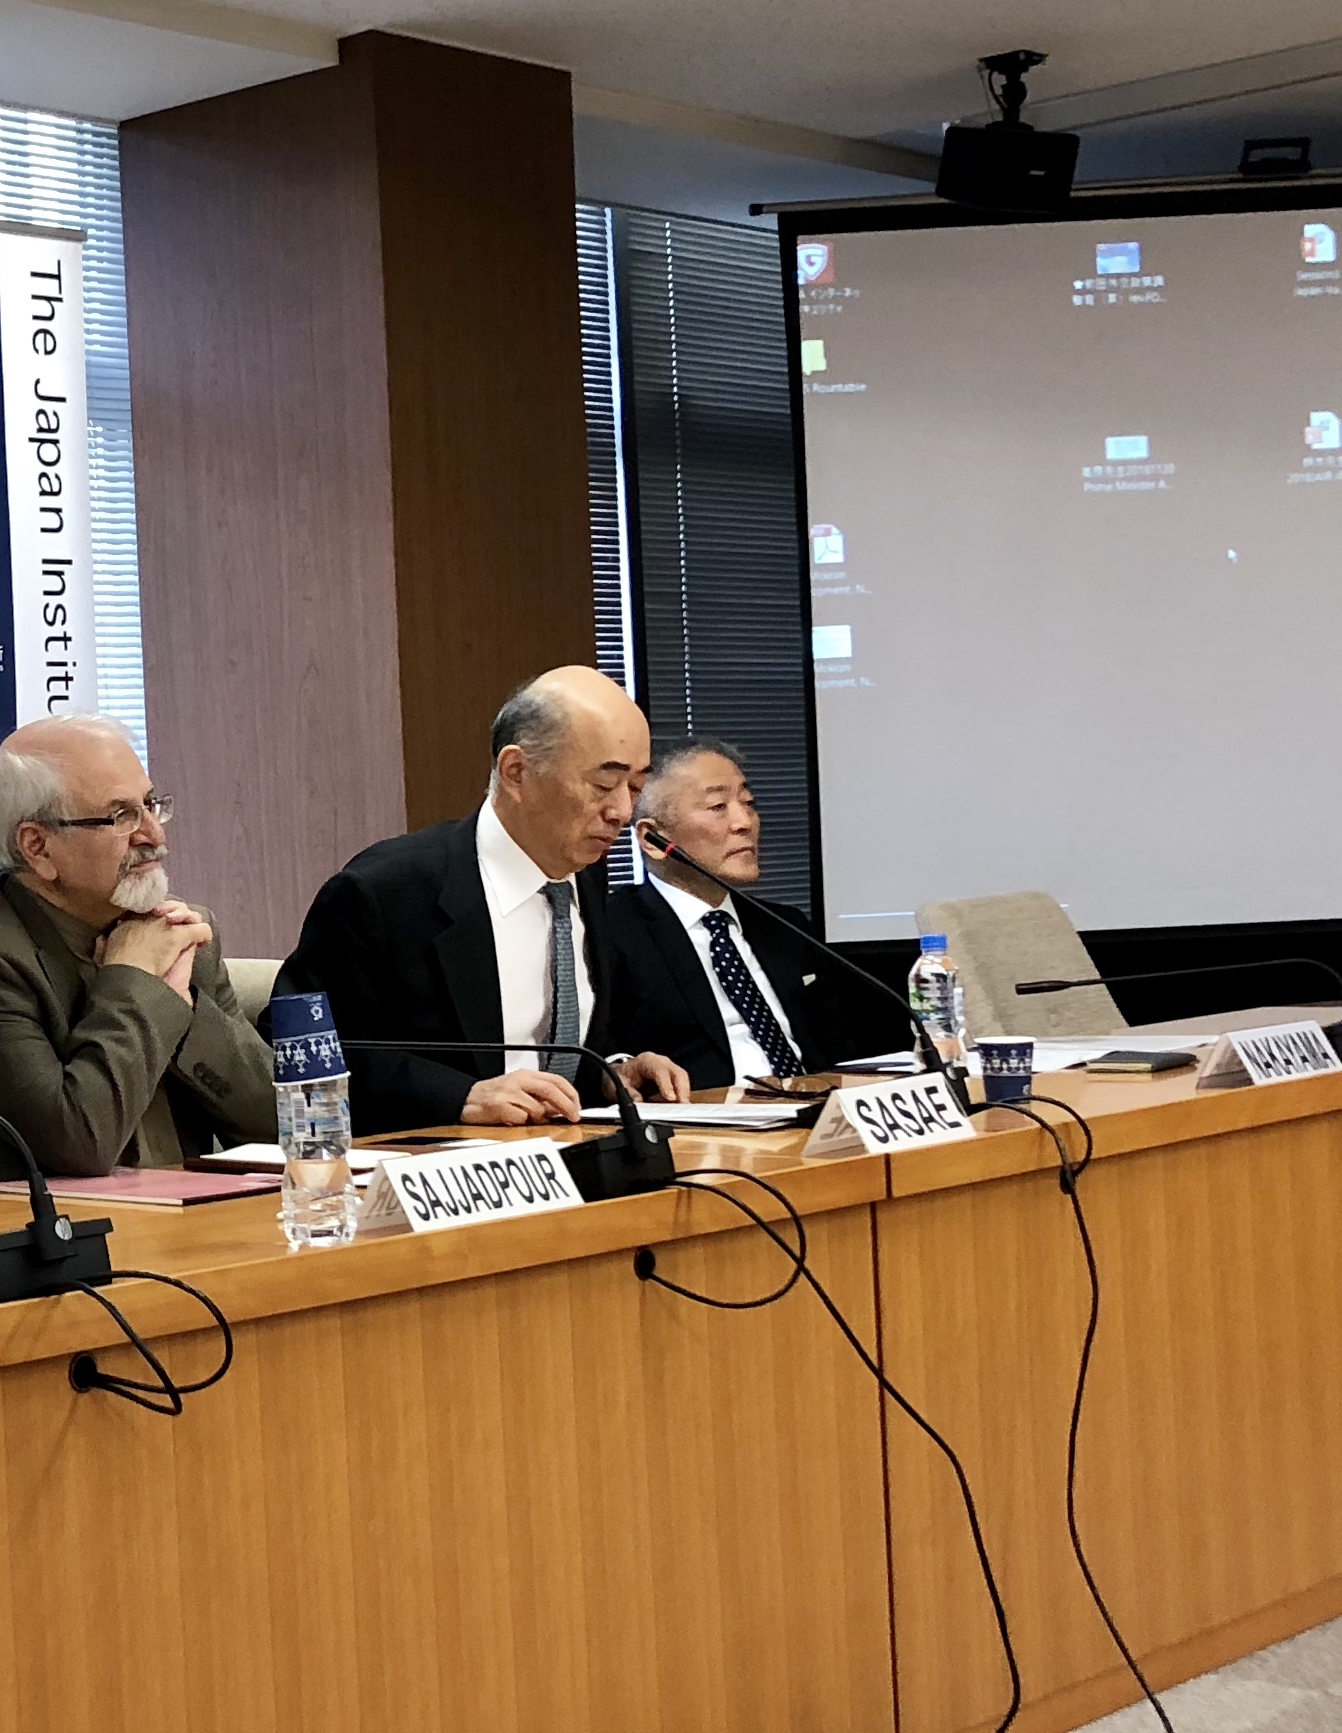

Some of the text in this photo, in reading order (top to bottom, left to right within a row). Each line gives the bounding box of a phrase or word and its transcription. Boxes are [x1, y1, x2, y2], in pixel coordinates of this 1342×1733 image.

[30, 259, 64, 356] The
[29, 378, 67, 535] Japan
[1238, 1030, 1337, 1080] NAKAYAMA
[855, 1085, 962, 1145] SASAE
[401, 1153, 570, 1221] SAJJADPOUR
